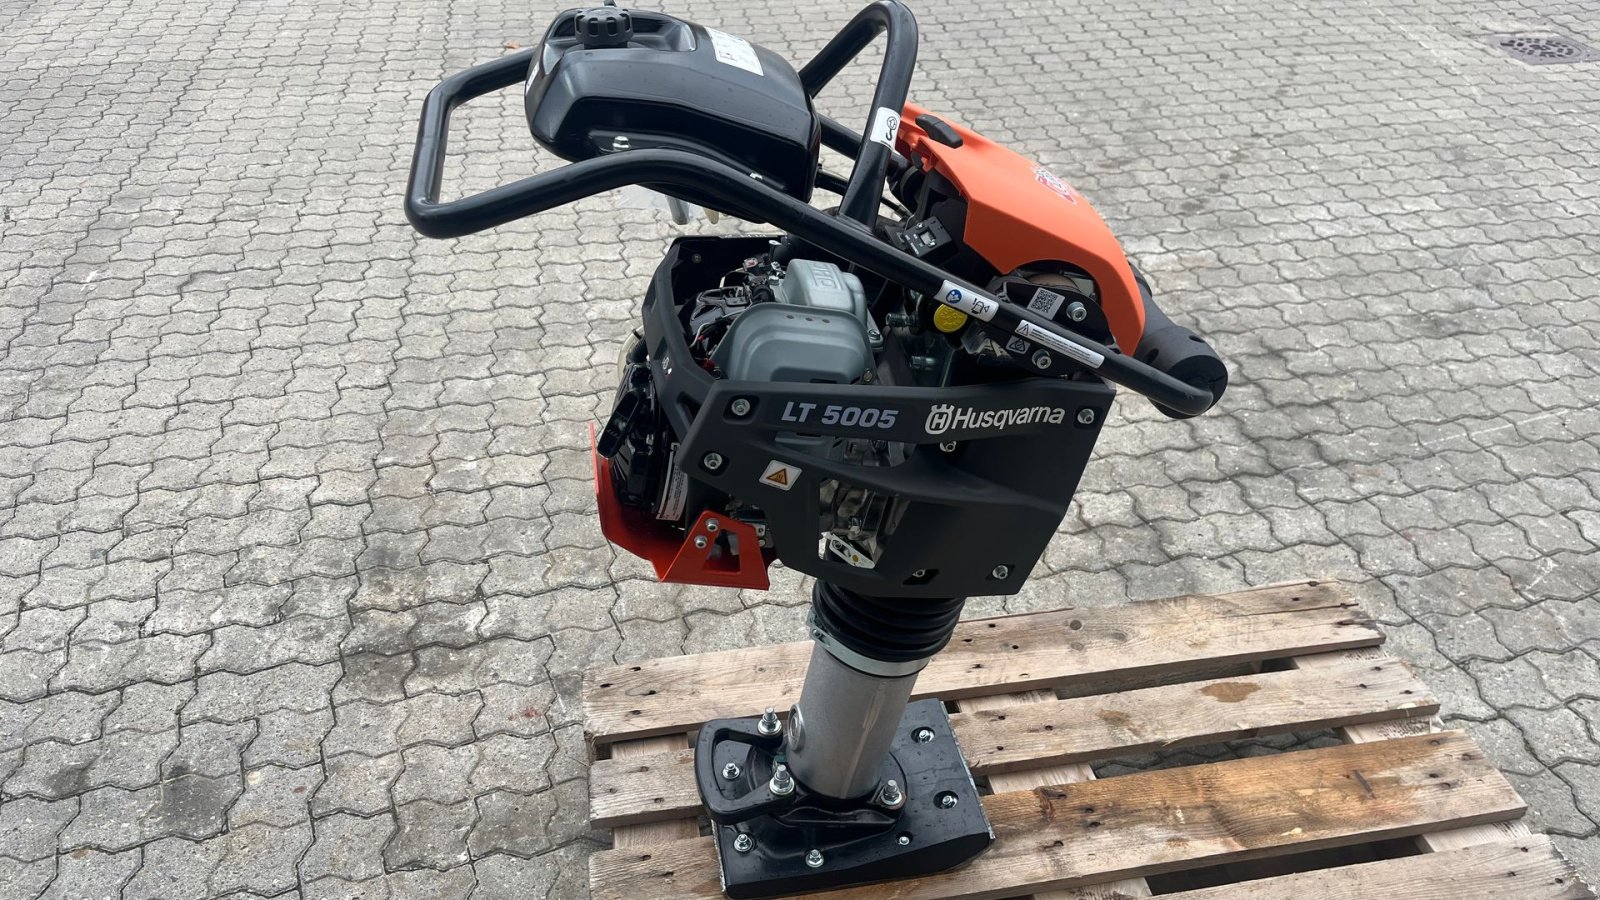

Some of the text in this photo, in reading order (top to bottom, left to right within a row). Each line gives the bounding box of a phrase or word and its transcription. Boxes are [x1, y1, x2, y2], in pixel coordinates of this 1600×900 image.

[781, 402, 899, 429] LT 5005
[952, 404, 1066, 430] Husqvarna
